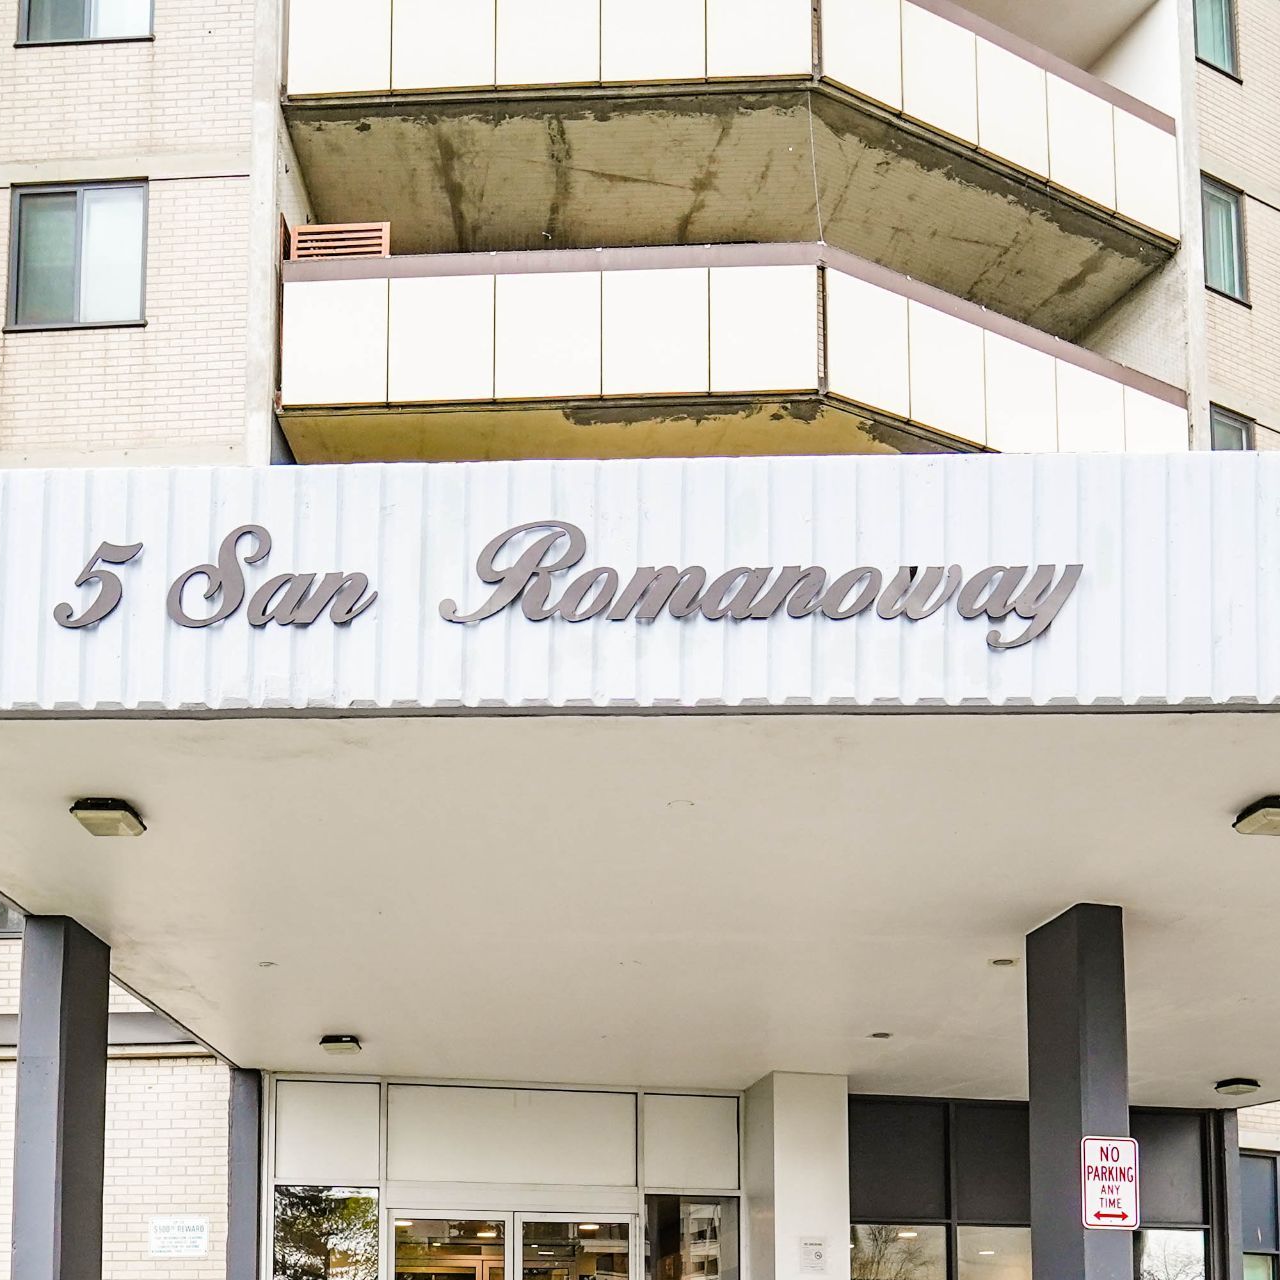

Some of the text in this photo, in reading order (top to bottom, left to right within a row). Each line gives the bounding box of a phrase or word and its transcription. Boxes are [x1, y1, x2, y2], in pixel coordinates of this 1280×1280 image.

[53, 520, 1084, 649] 5 San Romanoway
[1100, 1146, 1120, 1162] NO
[1087, 1165, 1134, 1182] PARKING
[1100, 1184, 1121, 1195] ANY
[1099, 1197, 1122, 1209] TIME
